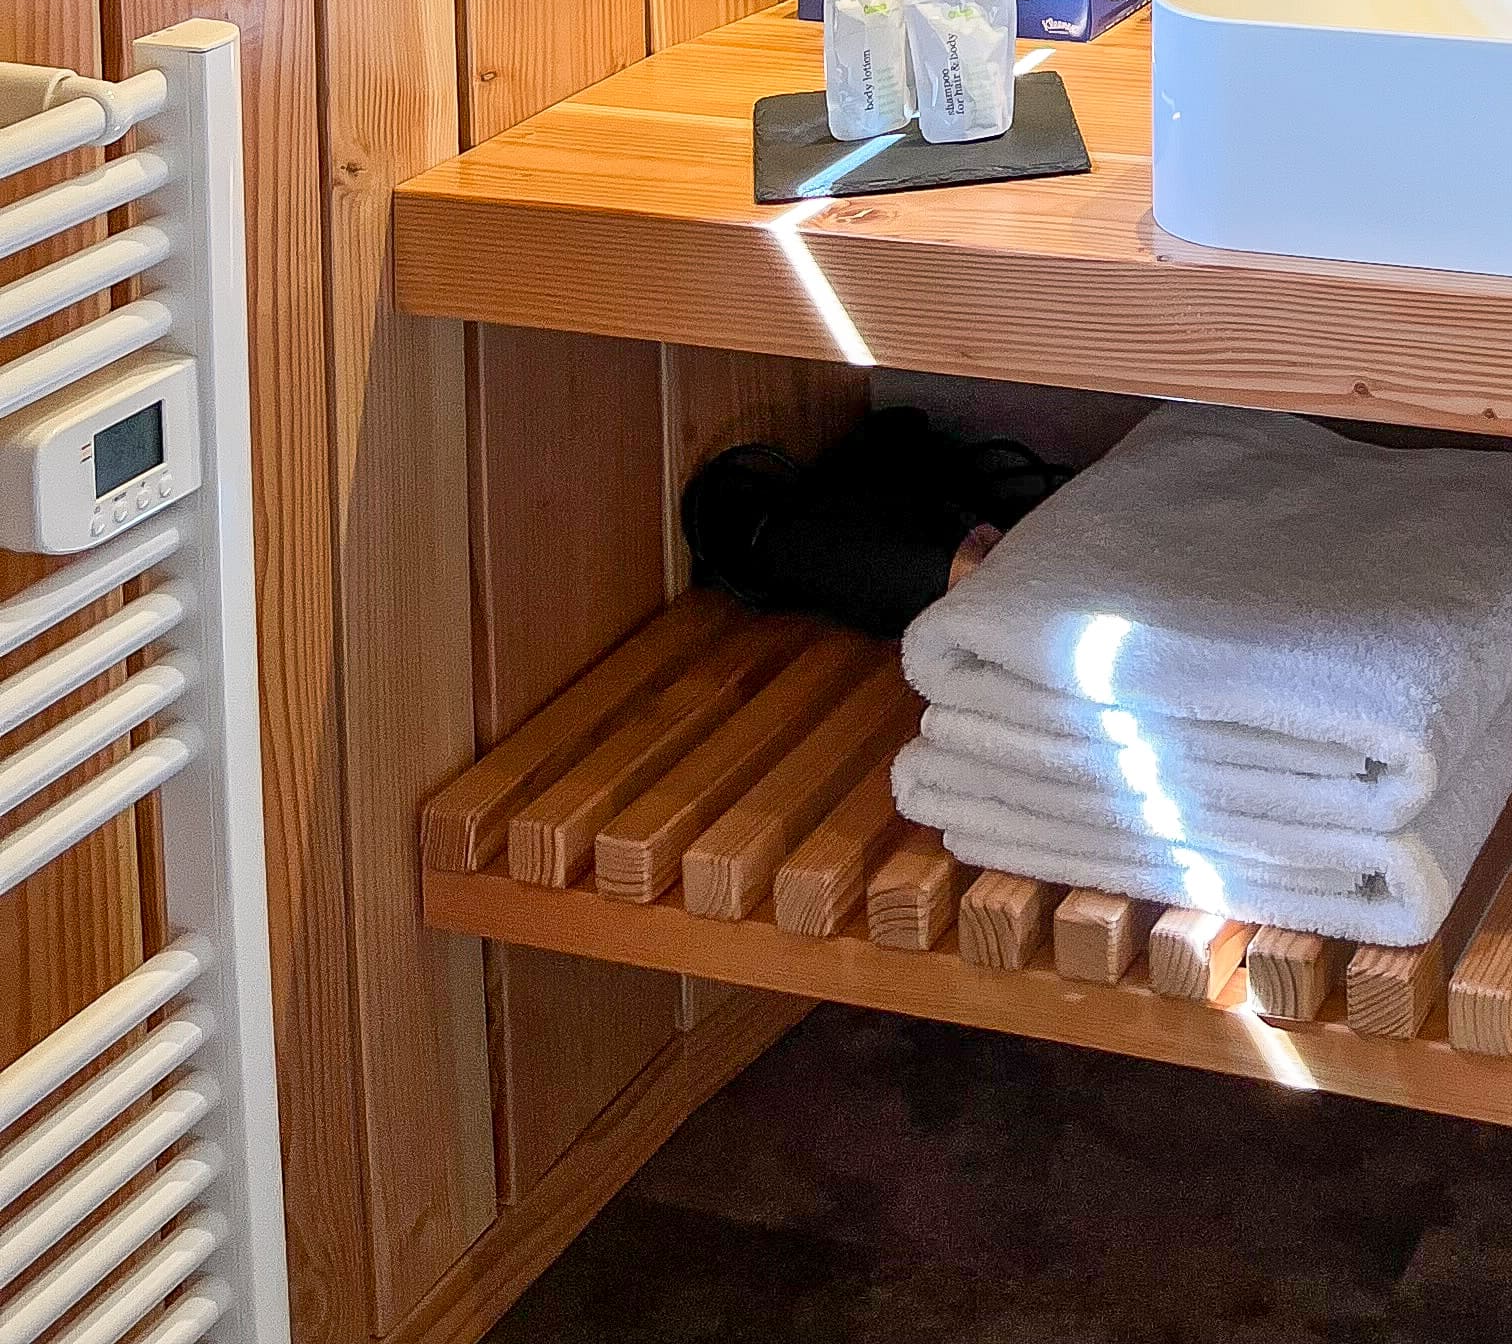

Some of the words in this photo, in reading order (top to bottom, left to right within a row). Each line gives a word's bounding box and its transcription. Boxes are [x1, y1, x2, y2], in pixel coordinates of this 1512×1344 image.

[946, 33, 959, 60] body
[862, 49, 873, 82] lotion
[950, 62, 960, 71] &
[863, 84, 875, 111] body
[942, 68, 955, 115] shampoo
[953, 74, 963, 97] hair
[955, 98, 965, 115] for
